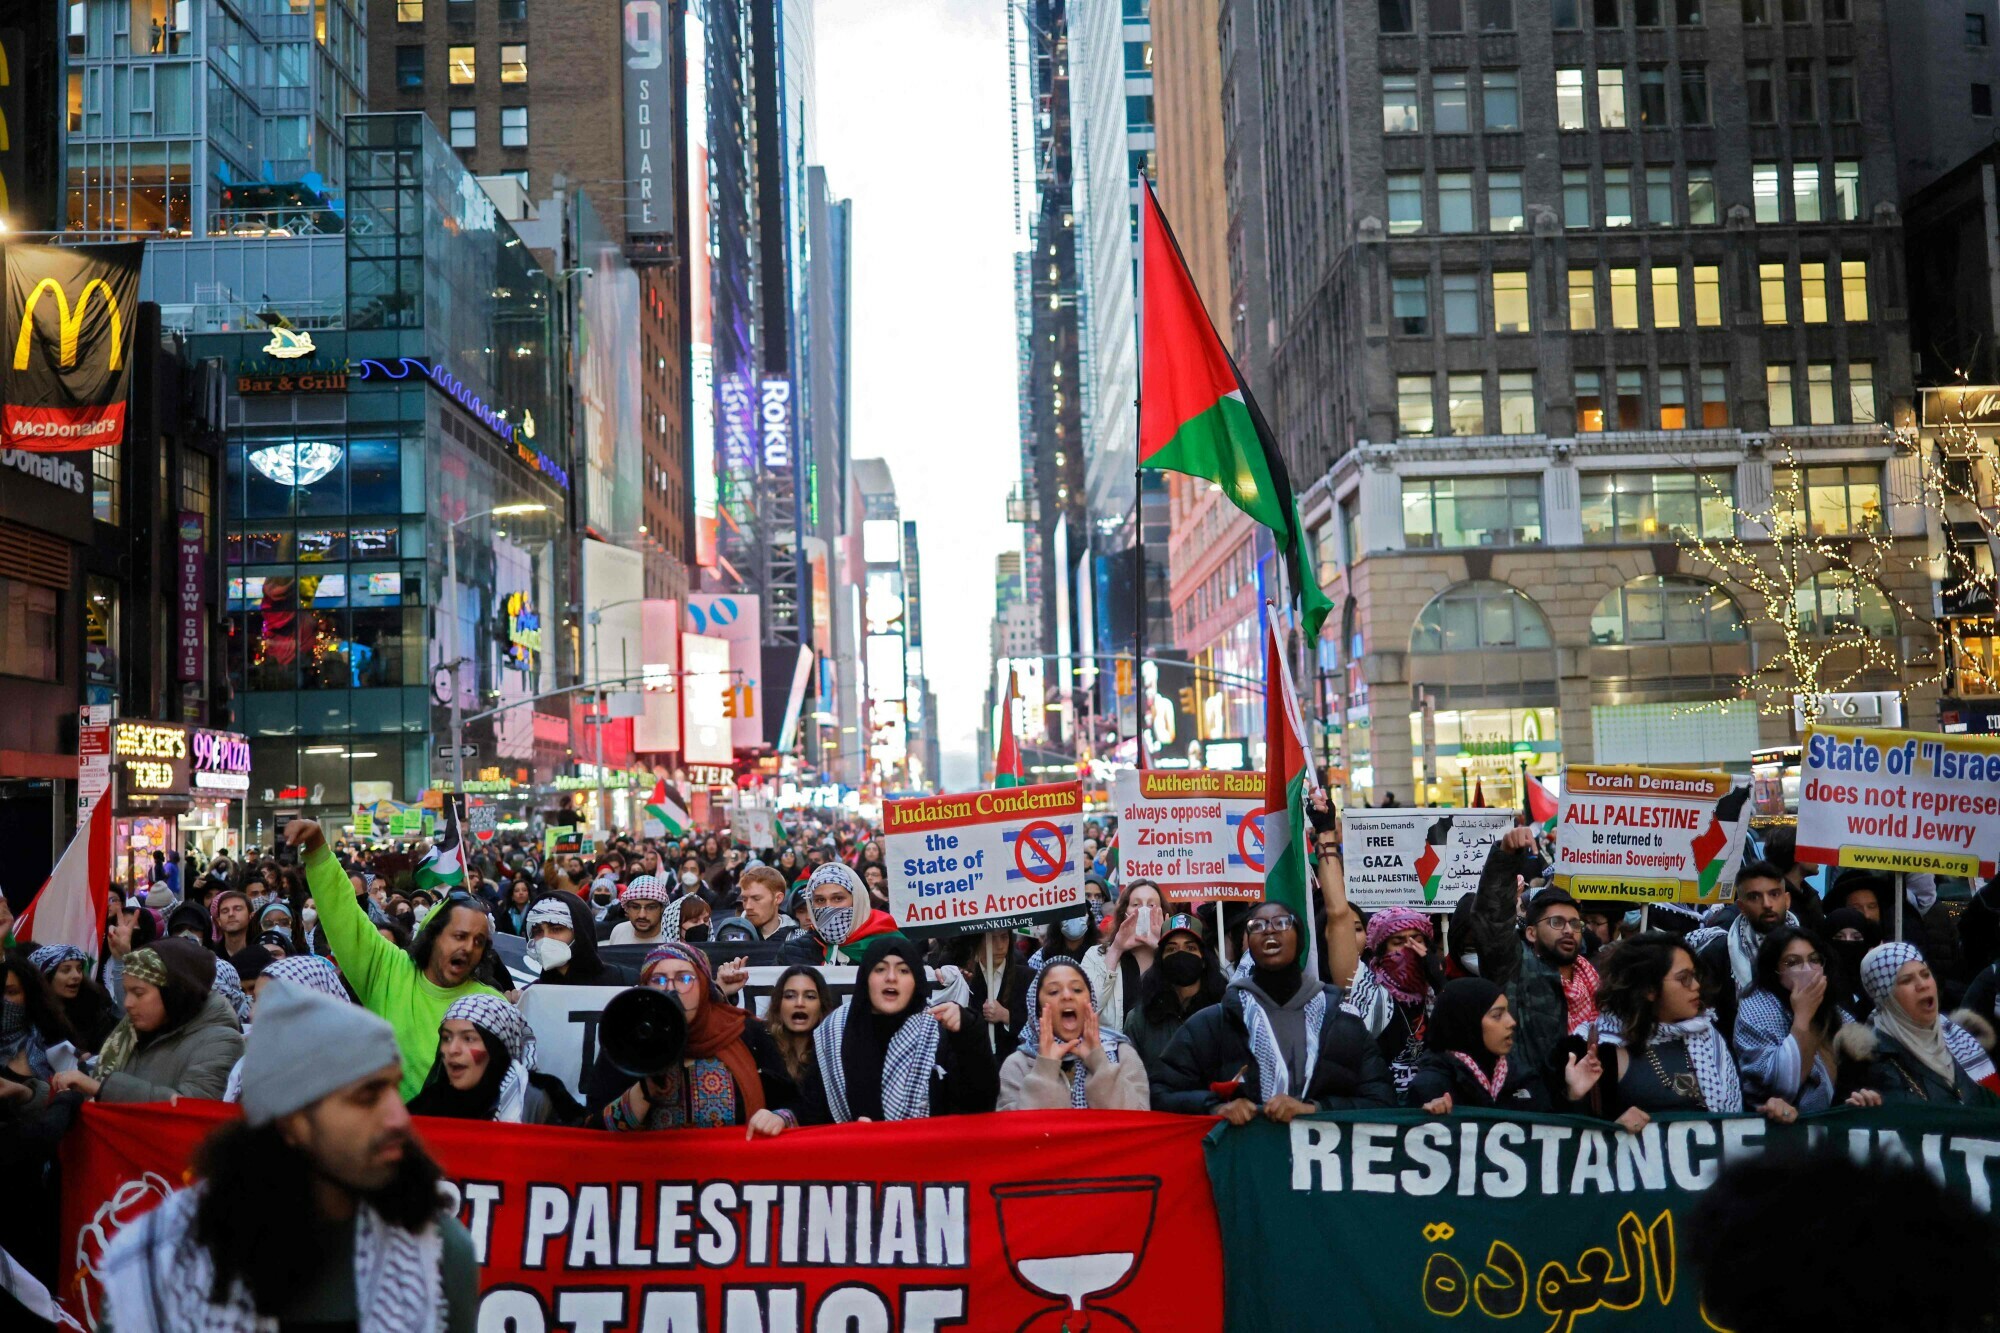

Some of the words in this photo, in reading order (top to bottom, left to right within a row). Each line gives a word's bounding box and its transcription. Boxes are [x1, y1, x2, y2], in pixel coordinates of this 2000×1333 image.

[638, 79, 652, 224] SQUARE
[238, 377, 272, 392] Bar
[278, 376, 293, 391] &
[298, 374, 347, 390] Grill
[12, 418, 116, 437] McDonald's
[762, 380, 790, 466] ROKU
[182, 544, 199, 611] MIDTOWN
[182, 618, 198, 675] COMICS
[117, 723, 186, 759] MOKER'S
[82, 757, 88, 766] 3
[220, 741, 251, 771] PIZZA
[1808, 734, 1879, 773] State
[1887, 741, 1916, 775] of
[1146, 774, 1220, 792] Authentic
[1586, 772, 1633, 788] Torah
[1639, 775, 1714, 793] Demands
[81, 798, 87, 806] 5
[1805, 778, 1858, 805] does
[1864, 786, 1906, 808] not
[1912, 792, 2000, 816] represe
[891, 801, 972, 826] Judaism
[976, 790, 1076, 816] Condemns
[1125, 803, 1167, 824] always
[1171, 802, 1222, 823] opposed
[1564, 804, 1599, 825] ALL
[1603, 804, 1700, 829] PALESTINE
[1137, 828, 1212, 845] Zionism
[1351, 823, 1379, 831] Judaism
[1381, 822, 1415, 830] Demands
[1847, 814, 1908, 838] world
[1912, 816, 1976, 848] Jewry
[926, 834, 958, 851] the
[1367, 836, 1394, 847] FREE
[1457, 832, 1495, 848] الحرية
[1592, 830, 1604, 844] be
[1606, 832, 1650, 846] returned
[1654, 834, 1663, 847] to
[903, 855, 958, 876] State
[963, 850, 984, 869] of
[1157, 848, 1175, 858] and
[1178, 848, 1193, 857] the
[1363, 855, 1403, 868] GAZA
[1463, 850, 1483, 861] غزة
[1561, 847, 1622, 865] Palestinian
[1625, 850, 1686, 871] Sovereignty
[1853, 853, 1969, 873] www.NKUSA.org
[1126, 859, 1163, 877] State
[1167, 858, 1181, 876] of
[1186, 858, 1225, 875] Israel
[1350, 875, 1360, 883] And
[1362, 874, 1376, 883] ALL
[1378, 874, 1418, 883] PALESTINE
[1170, 886, 1261, 899] www.NKUSA.org
[1578, 883, 1674, 897] www.nkusa.org
[906, 900, 946, 922] And
[953, 897, 978, 917] its
[985, 885, 1076, 914] Atrocities
[960, 917, 1034, 932] www.NKUSA.org
[1290, 1118, 1766, 1198] RESISTANCE
[525, 1183, 966, 1267] PALESTINIAN
[1422, 1208, 1677, 1333] العودة
